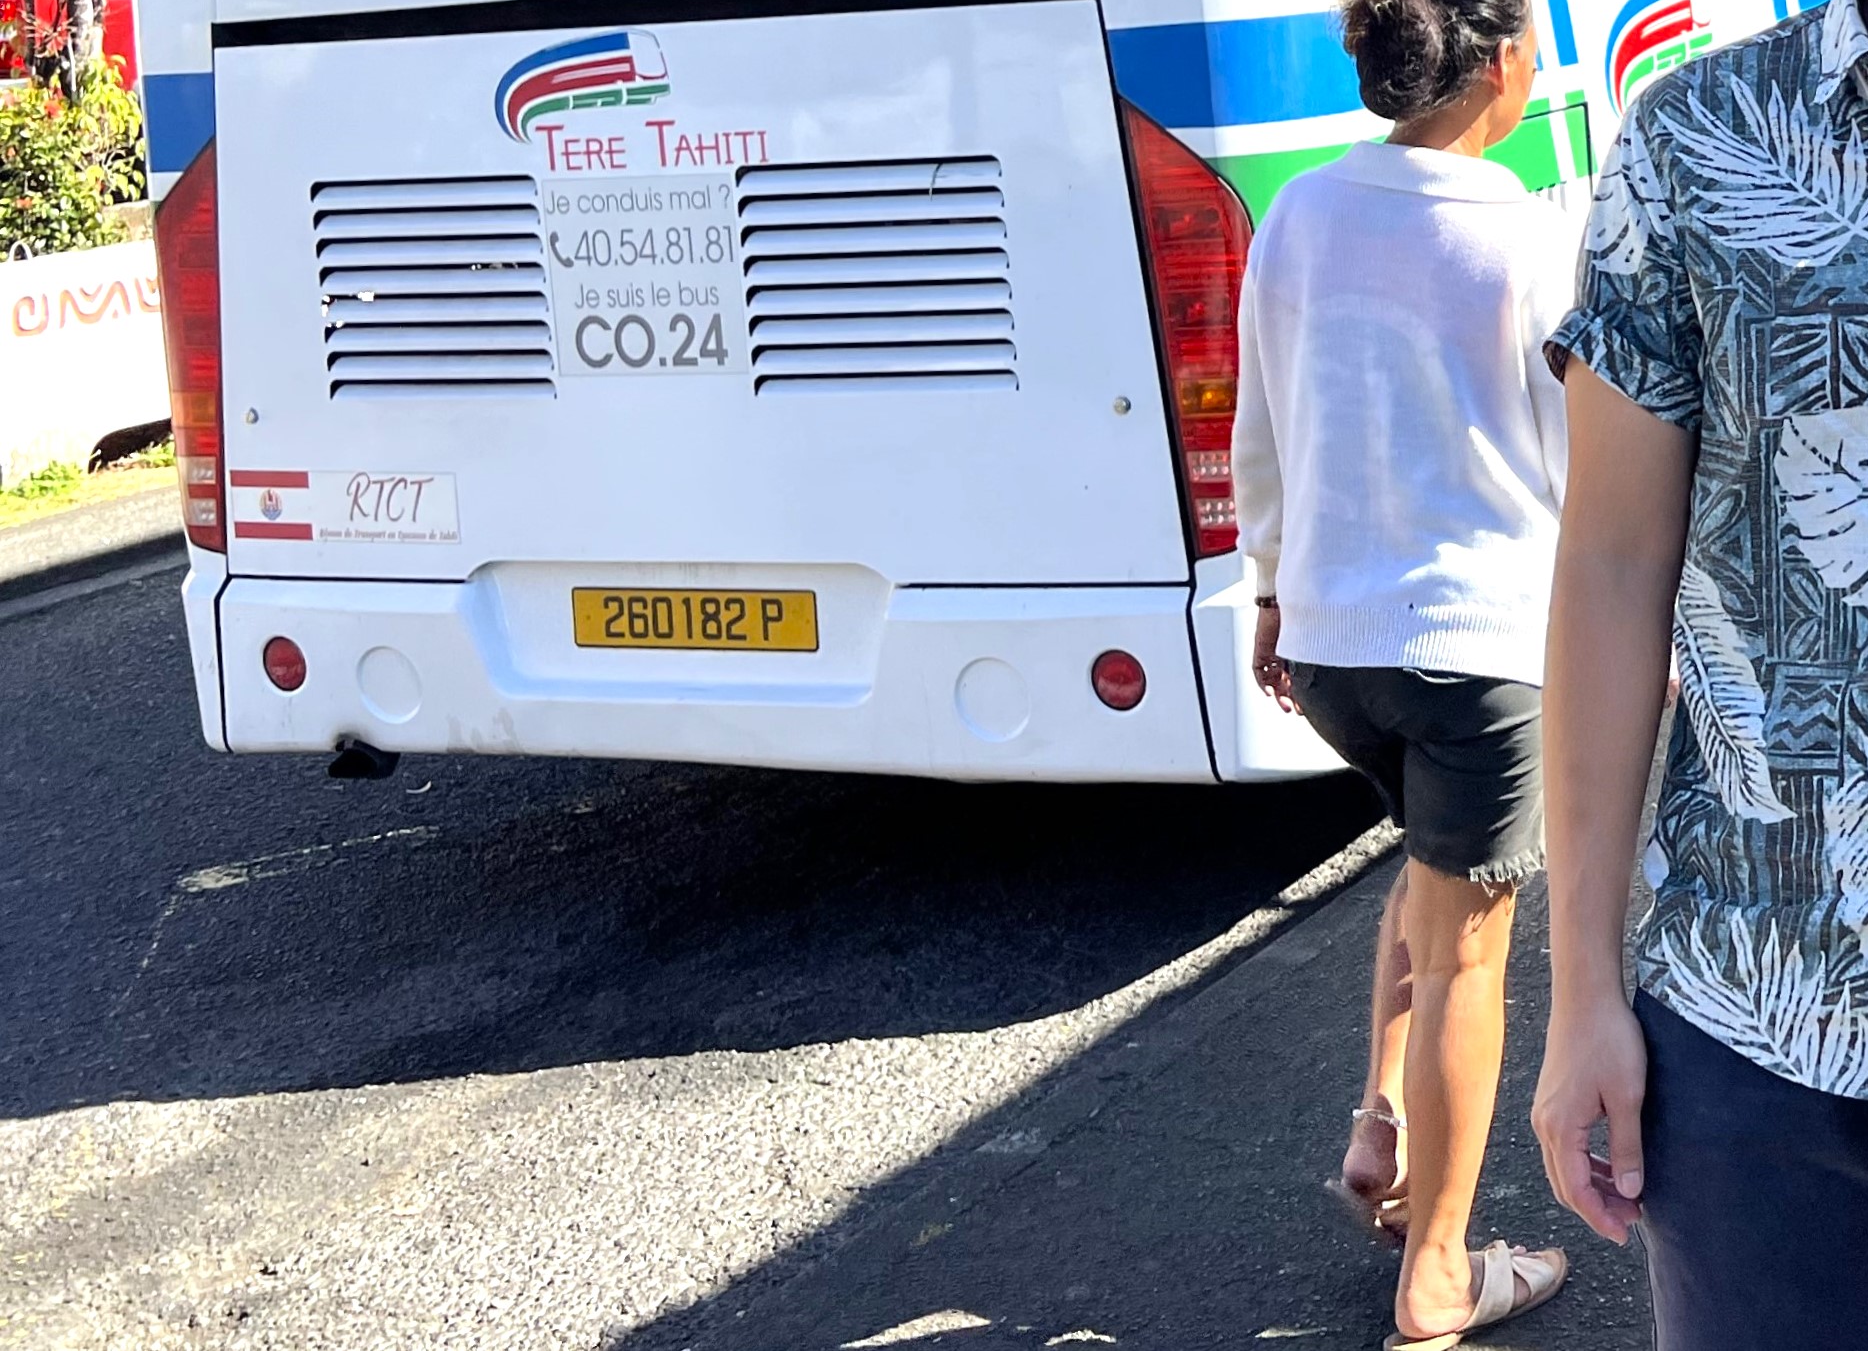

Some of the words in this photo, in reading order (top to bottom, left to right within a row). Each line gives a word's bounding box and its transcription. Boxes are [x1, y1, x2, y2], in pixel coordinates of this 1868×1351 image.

[546, 190, 571, 215] Je
[577, 187, 663, 213] conduis
[669, 184, 712, 210] mal
[718, 183, 731, 209] ?
[573, 225, 735, 267] 40.54.81.81
[574, 283, 600, 309] Je
[606, 282, 645, 308] suis
[651, 281, 671, 307] le
[678, 279, 720, 306] bus
[574, 311, 729, 369] CO.24
[346, 471, 435, 523] RTCT
[602, 595, 748, 642] 260182
[760, 597, 784, 642] P
